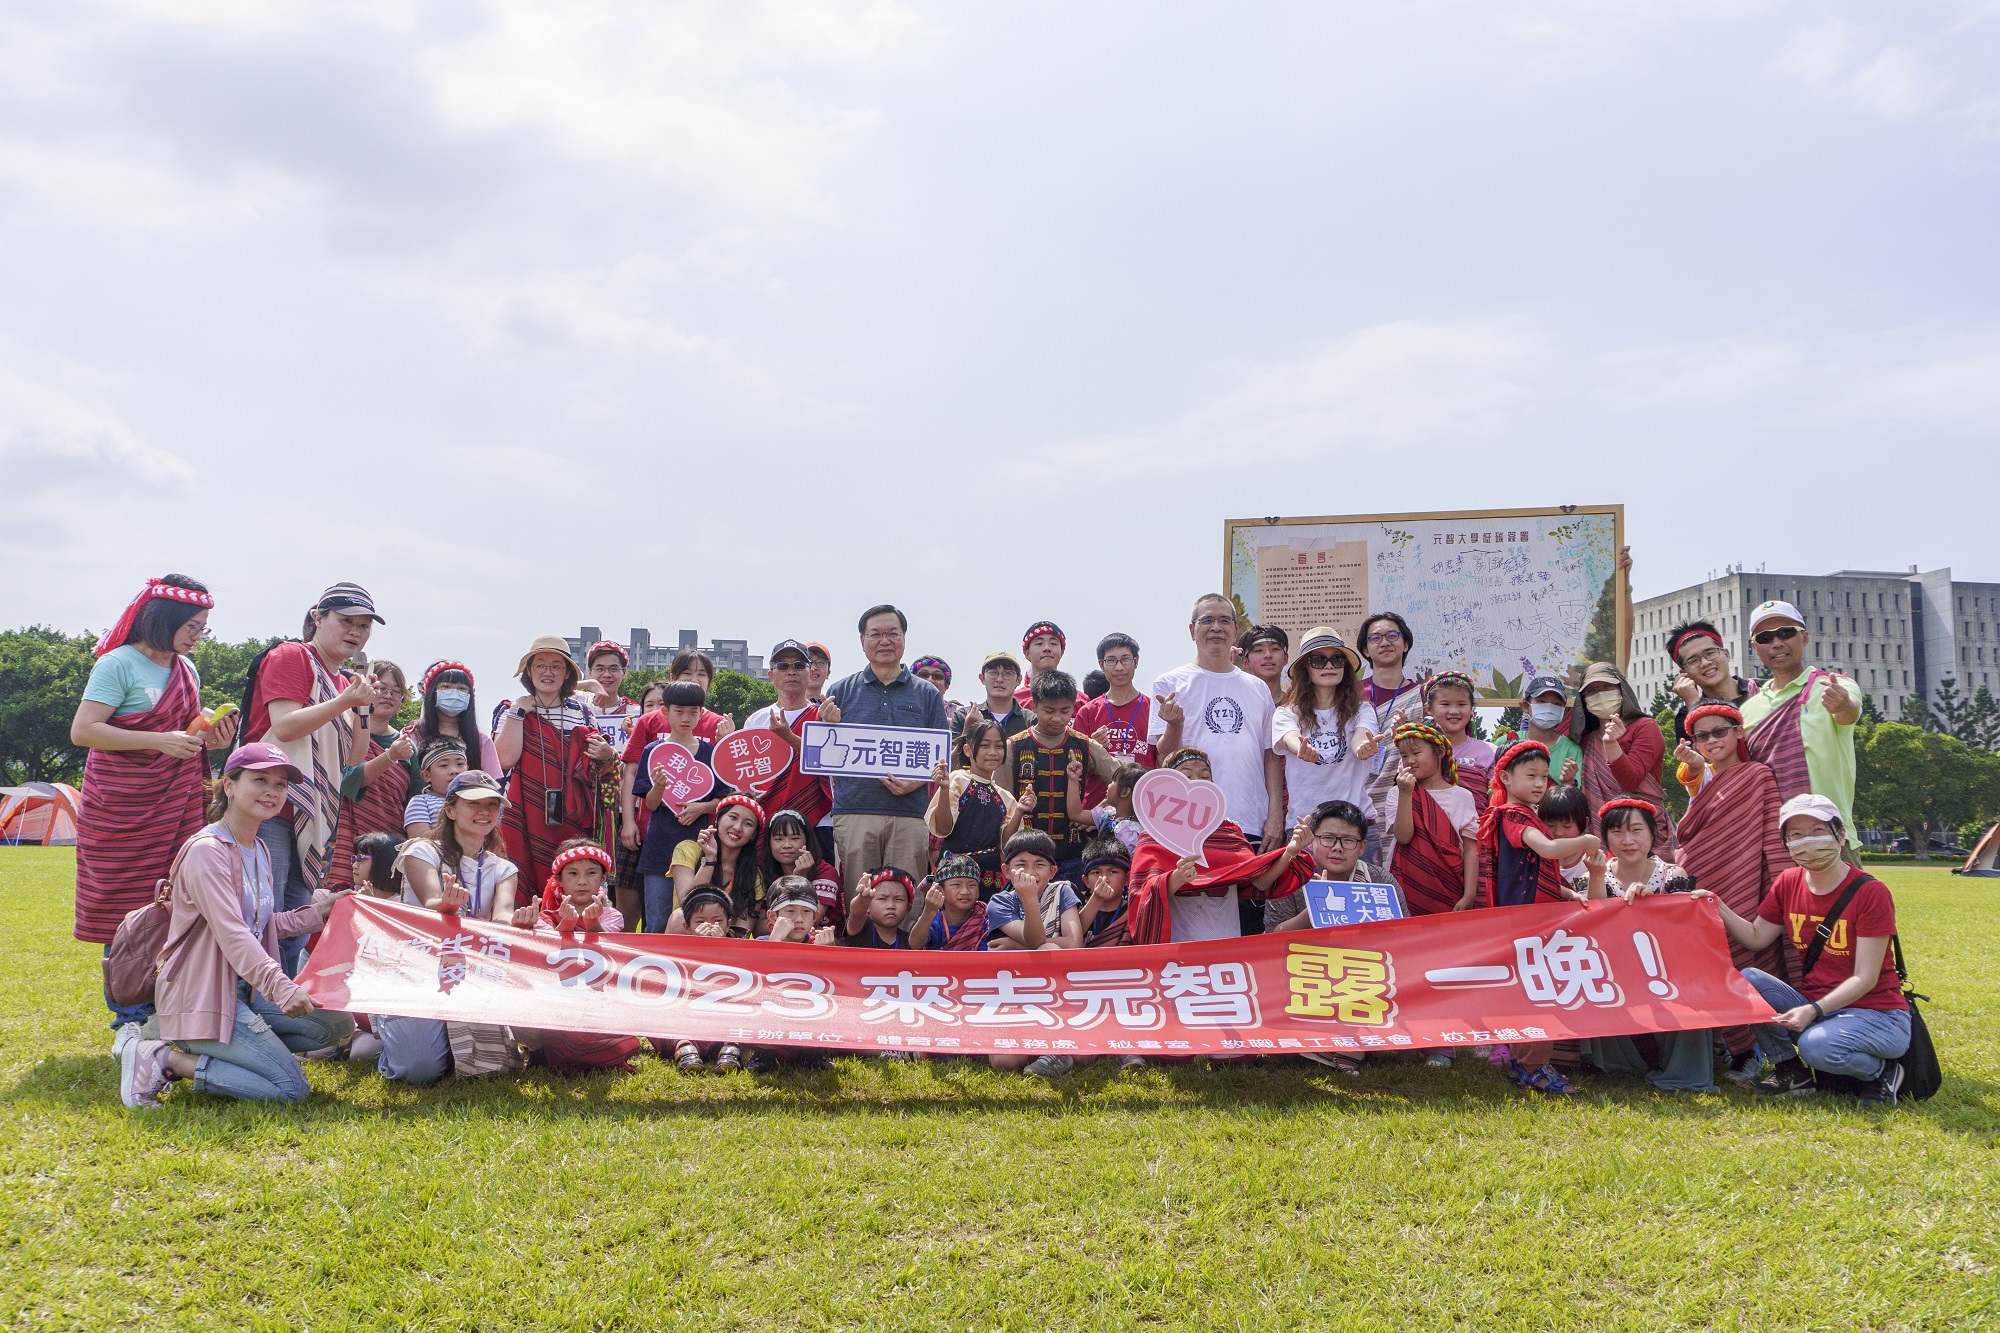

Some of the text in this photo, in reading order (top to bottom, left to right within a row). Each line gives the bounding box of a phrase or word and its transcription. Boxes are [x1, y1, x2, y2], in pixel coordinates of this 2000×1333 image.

[1213, 708, 1235, 719] YZU
[728, 738, 750, 759] 我
[667, 752, 688, 774] 我
[735, 756, 772, 781] 元智
[661, 769, 692, 800] 元智
[1146, 790, 1212, 831] YZU
[1351, 885, 1390, 905] 元智
[1319, 911, 1349, 926] Like
[1356, 906, 1394, 924] 大學
[356, 932, 513, 963] 低碳生活
[540, 947, 834, 1019] 2023
